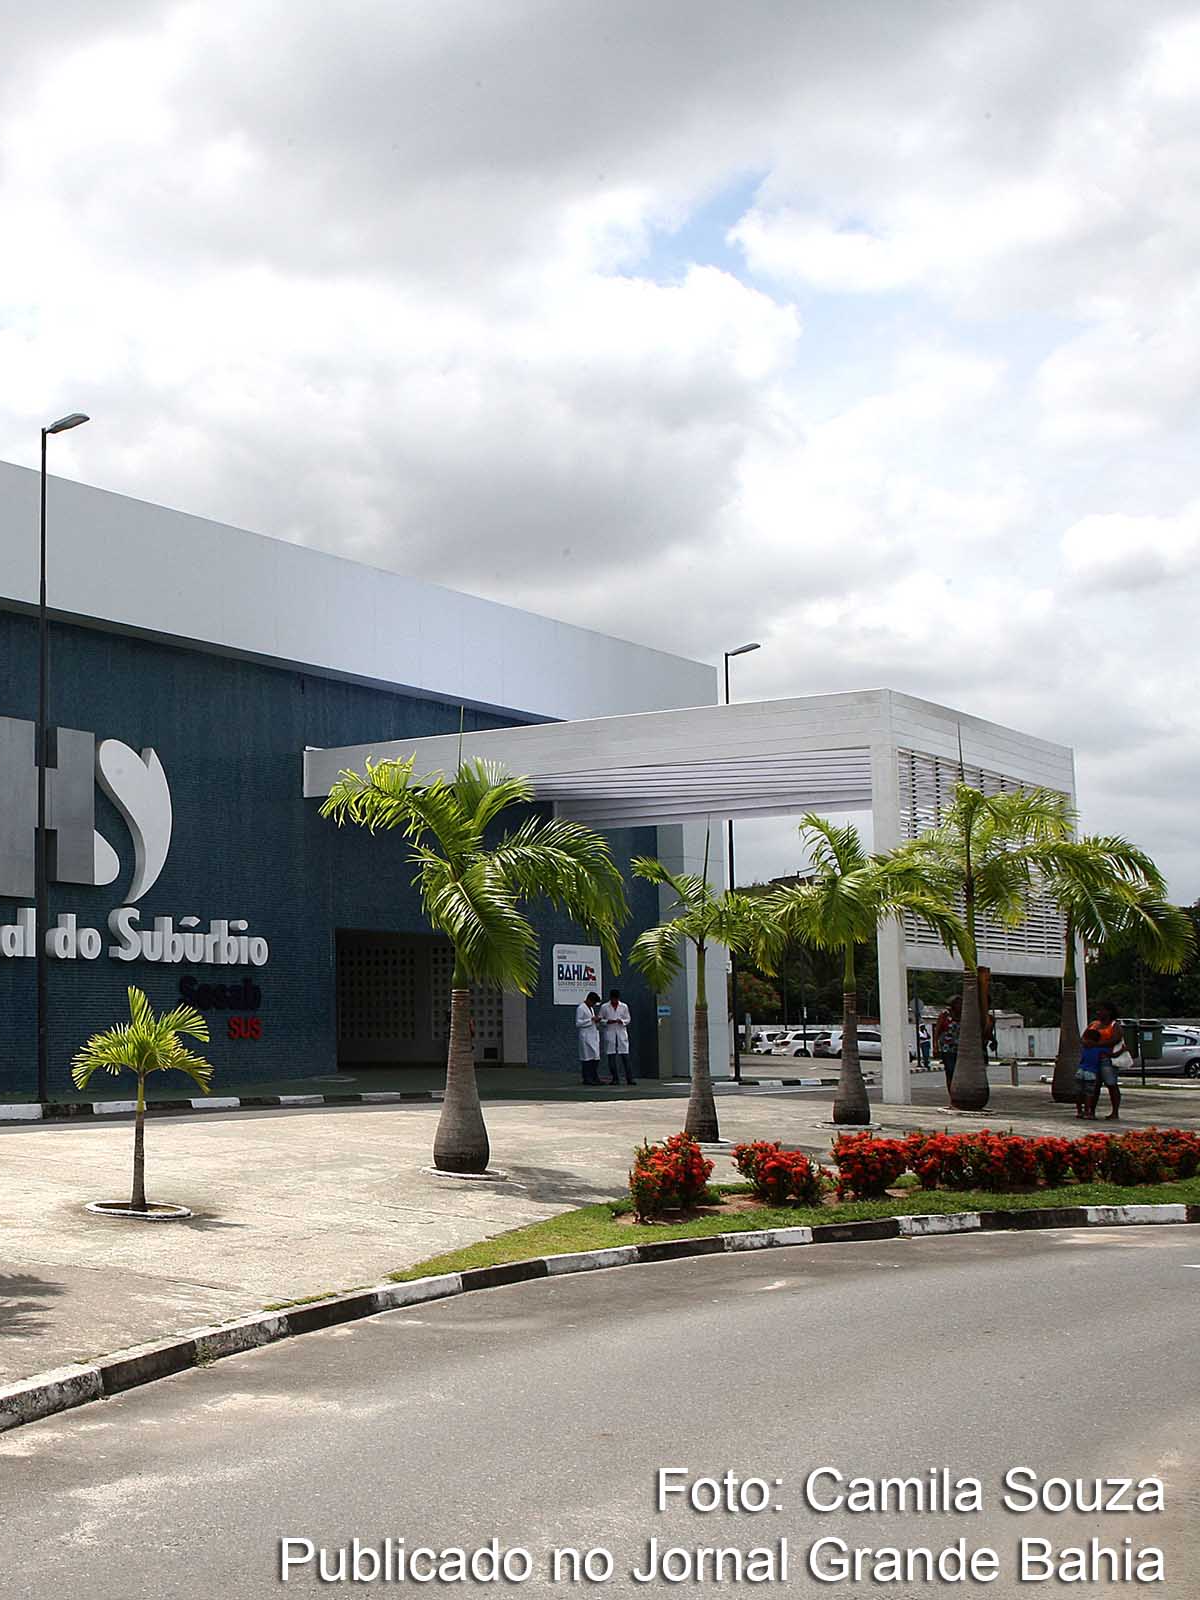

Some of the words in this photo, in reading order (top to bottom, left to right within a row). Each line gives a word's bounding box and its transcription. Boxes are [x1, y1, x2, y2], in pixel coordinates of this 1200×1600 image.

[45, 913, 101, 960] do
[108, 907, 269, 967] Subúrbio
[557, 963, 597, 981] BAHIA
[227, 1015, 264, 1040] SUS
